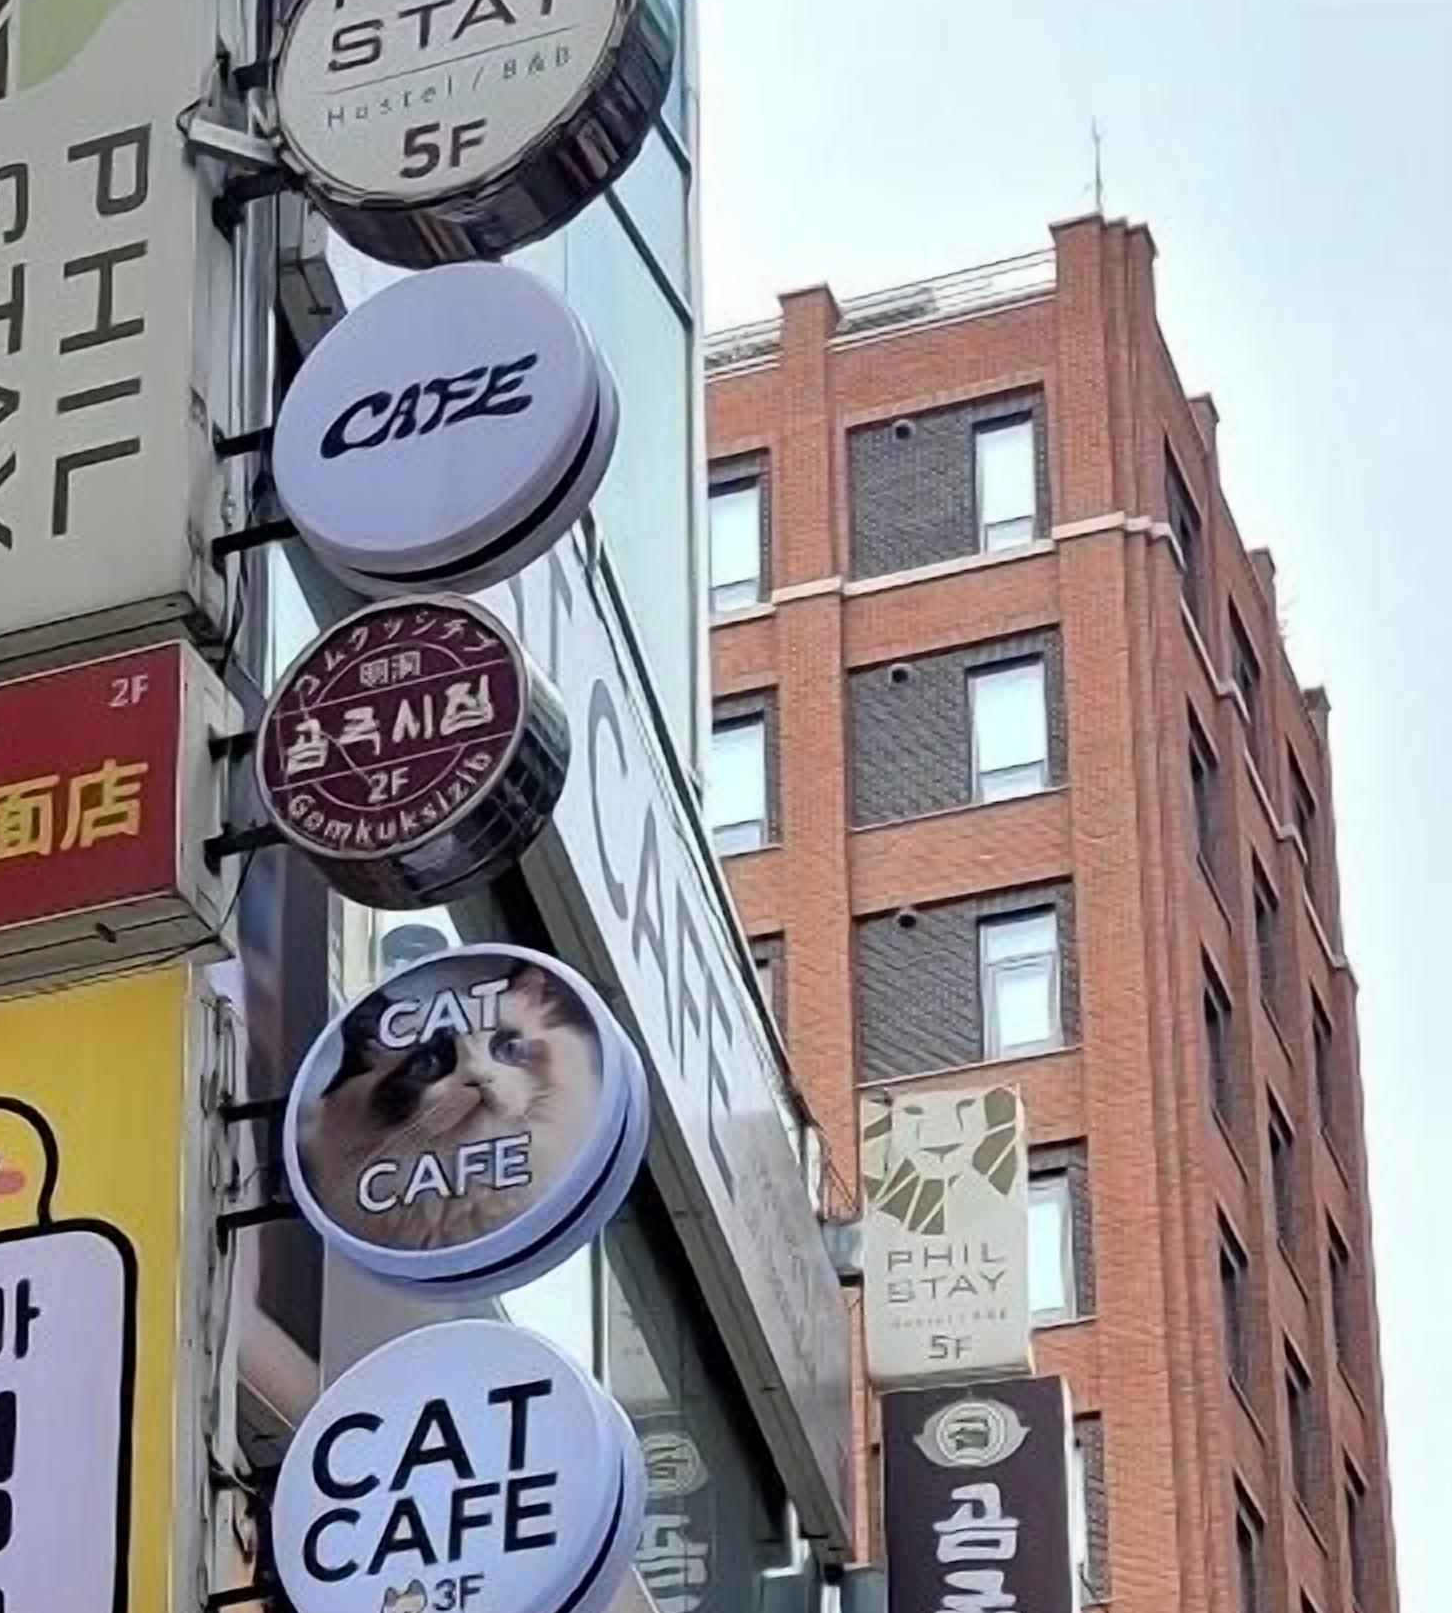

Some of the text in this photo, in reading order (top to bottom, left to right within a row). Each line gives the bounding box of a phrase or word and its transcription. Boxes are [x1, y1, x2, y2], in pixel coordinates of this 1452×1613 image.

[326, 75, 455, 126] Hostel
[400, 117, 487, 179] 5F
[52, 122, 150, 537] PHIL
[321, 353, 538, 458] CAFE
[108, 675, 148, 709] 2F
[368, 767, 409, 803] 2F
[379, 980, 509, 1050] CAT
[357, 1133, 531, 1213] CAFE
[887, 1242, 1008, 1273] PHIL
[887, 1272, 1006, 1303] STAY
[928, 1335, 973, 1360] 5F
[312, 1379, 554, 1500] CAT
[303, 1473, 558, 1584] CAFE
[430, 1574, 484, 1613] 3F
